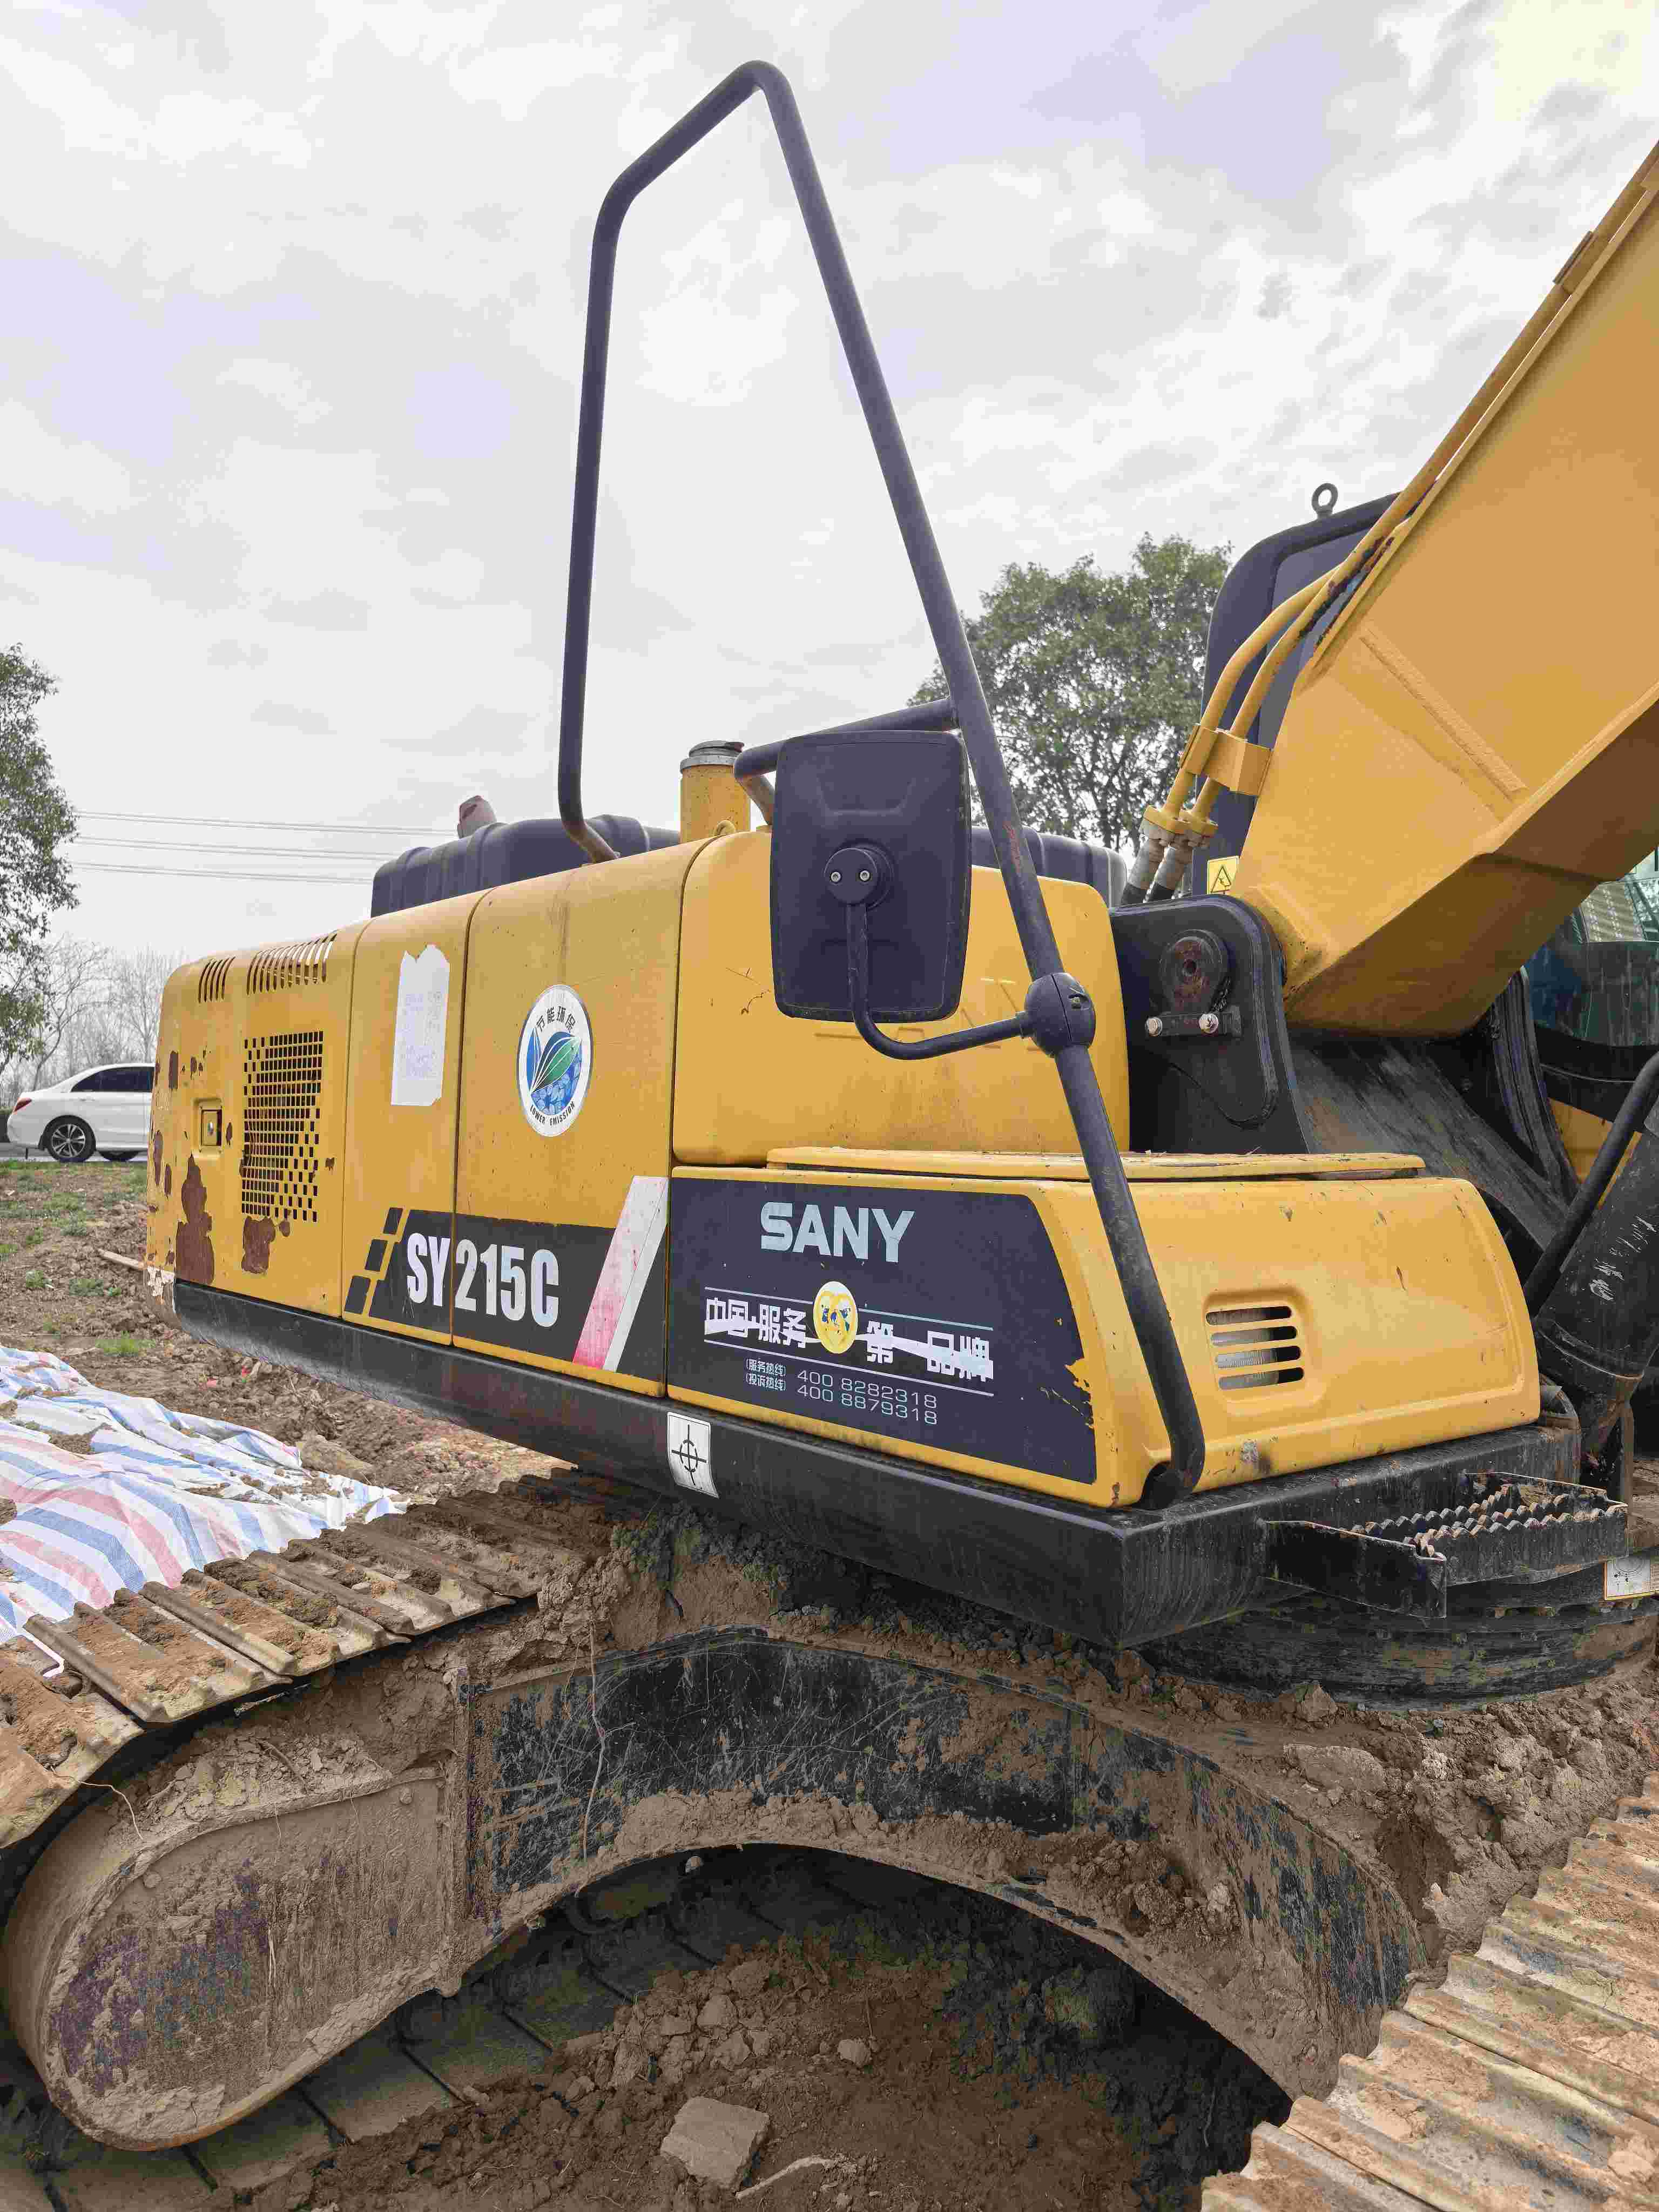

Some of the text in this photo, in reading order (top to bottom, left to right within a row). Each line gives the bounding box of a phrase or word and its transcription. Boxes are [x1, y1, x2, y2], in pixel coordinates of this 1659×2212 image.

[550, 1101, 575, 1126] EMISSION
[760, 1201, 915, 1263] SANY
[407, 1232, 559, 1327] SY215C
[797, 1370, 833, 1387] 400
[841, 1378, 937, 1409] 8282318
[797, 1385, 833, 1402] 400
[841, 1393, 937, 1425] 8879318
